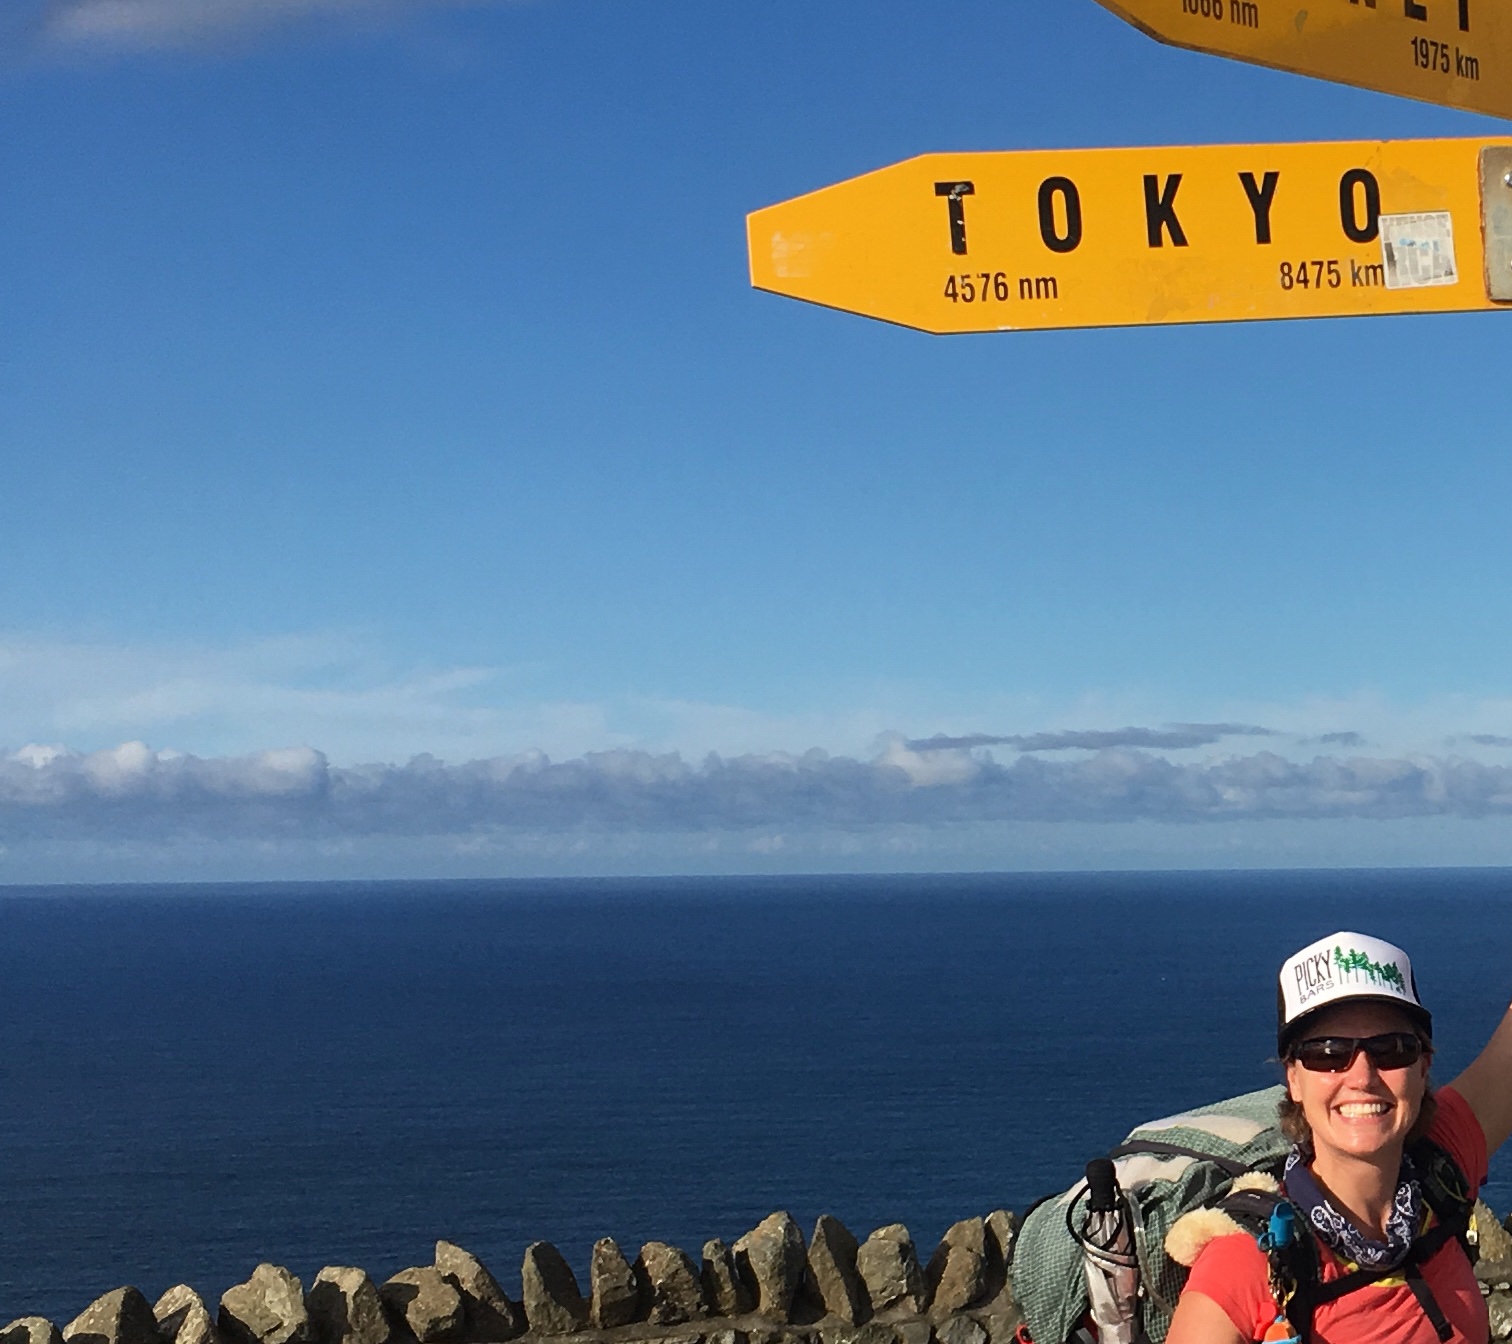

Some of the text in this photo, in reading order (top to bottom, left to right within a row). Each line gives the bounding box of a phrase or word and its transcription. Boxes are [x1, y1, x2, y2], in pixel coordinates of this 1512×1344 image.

[1409, 35, 1481, 82] 1975 km
[933, 166, 1382, 257] TOKYO
[942, 271, 1060, 305] 4576 nm
[1279, 258, 1386, 292] 8475 km
[1295, 949, 1332, 996] PICKY
[1300, 979, 1335, 1005] BARS
